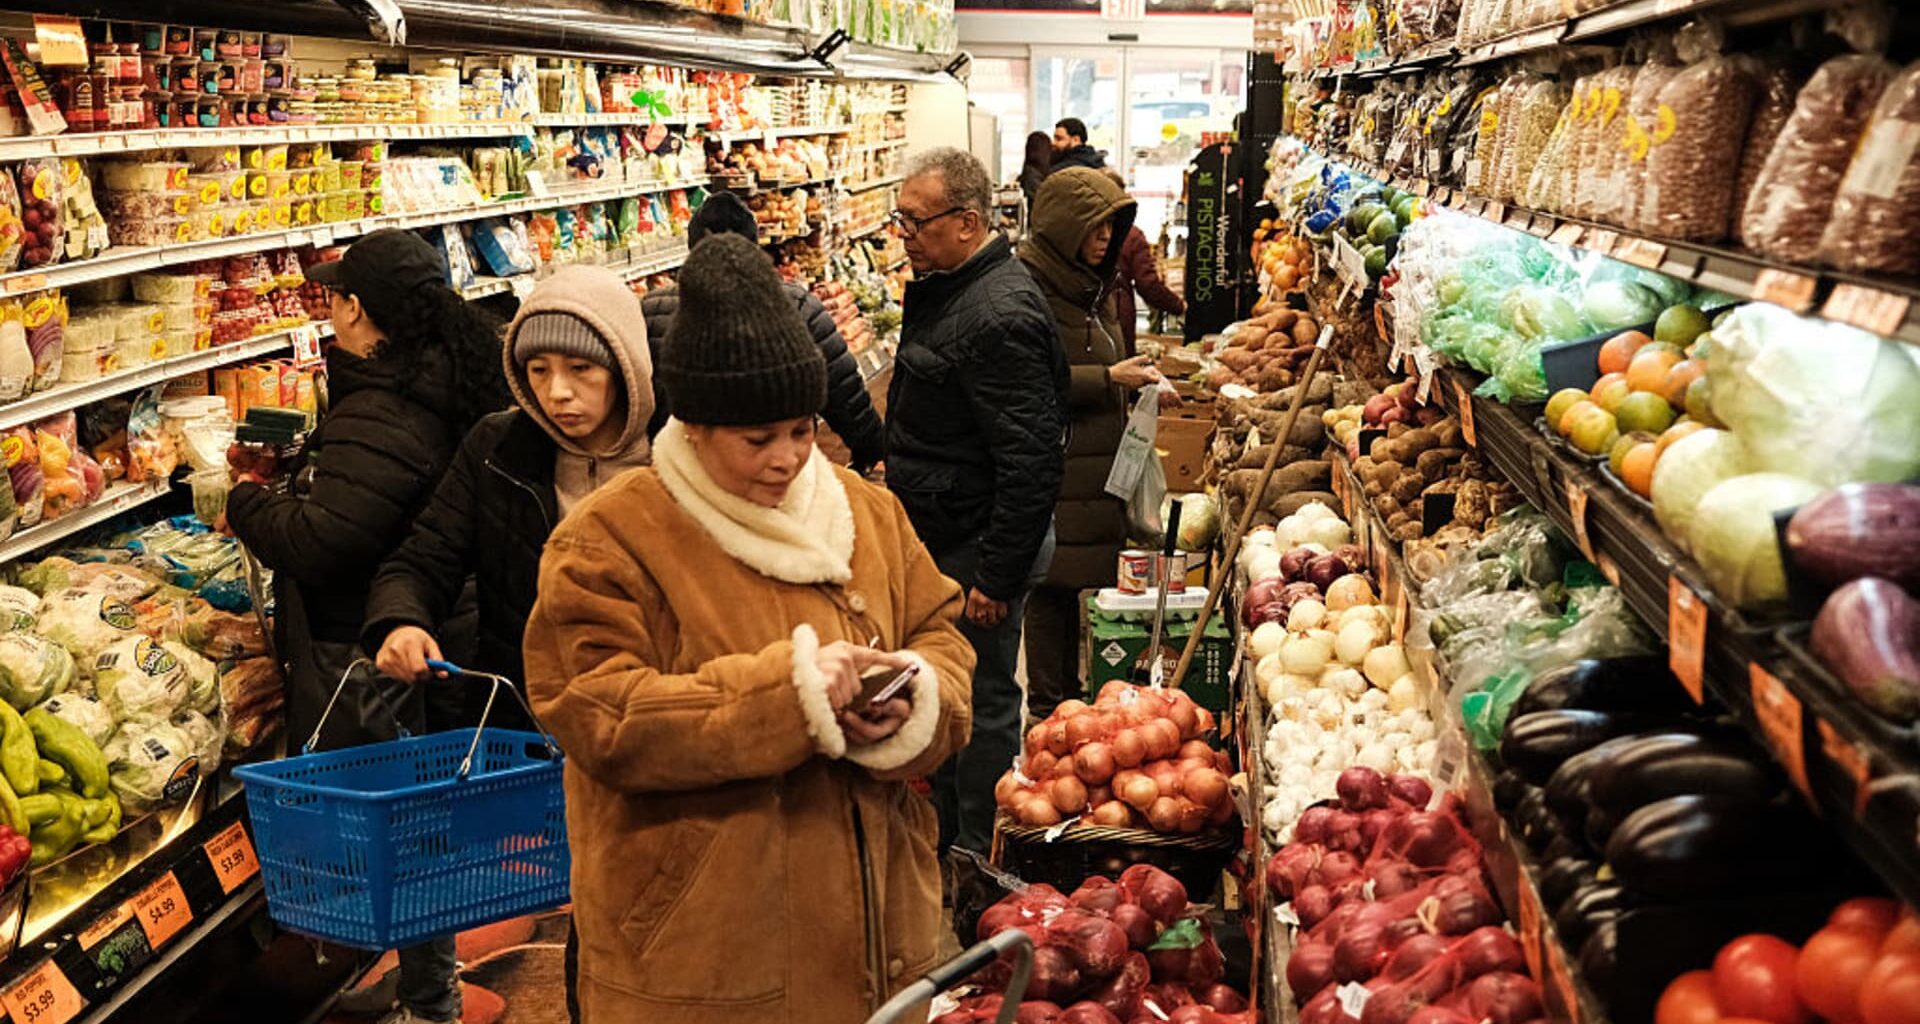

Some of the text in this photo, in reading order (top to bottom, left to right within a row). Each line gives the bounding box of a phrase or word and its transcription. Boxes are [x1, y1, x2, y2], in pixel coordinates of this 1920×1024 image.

[1195, 198, 1214, 302] PISTACHIOS
[1215, 214, 1230, 287] Wonderful
[221, 849, 245, 875] $3.99
[149, 897, 176, 924] $4.99
[23, 989, 56, 1023] $3.99
